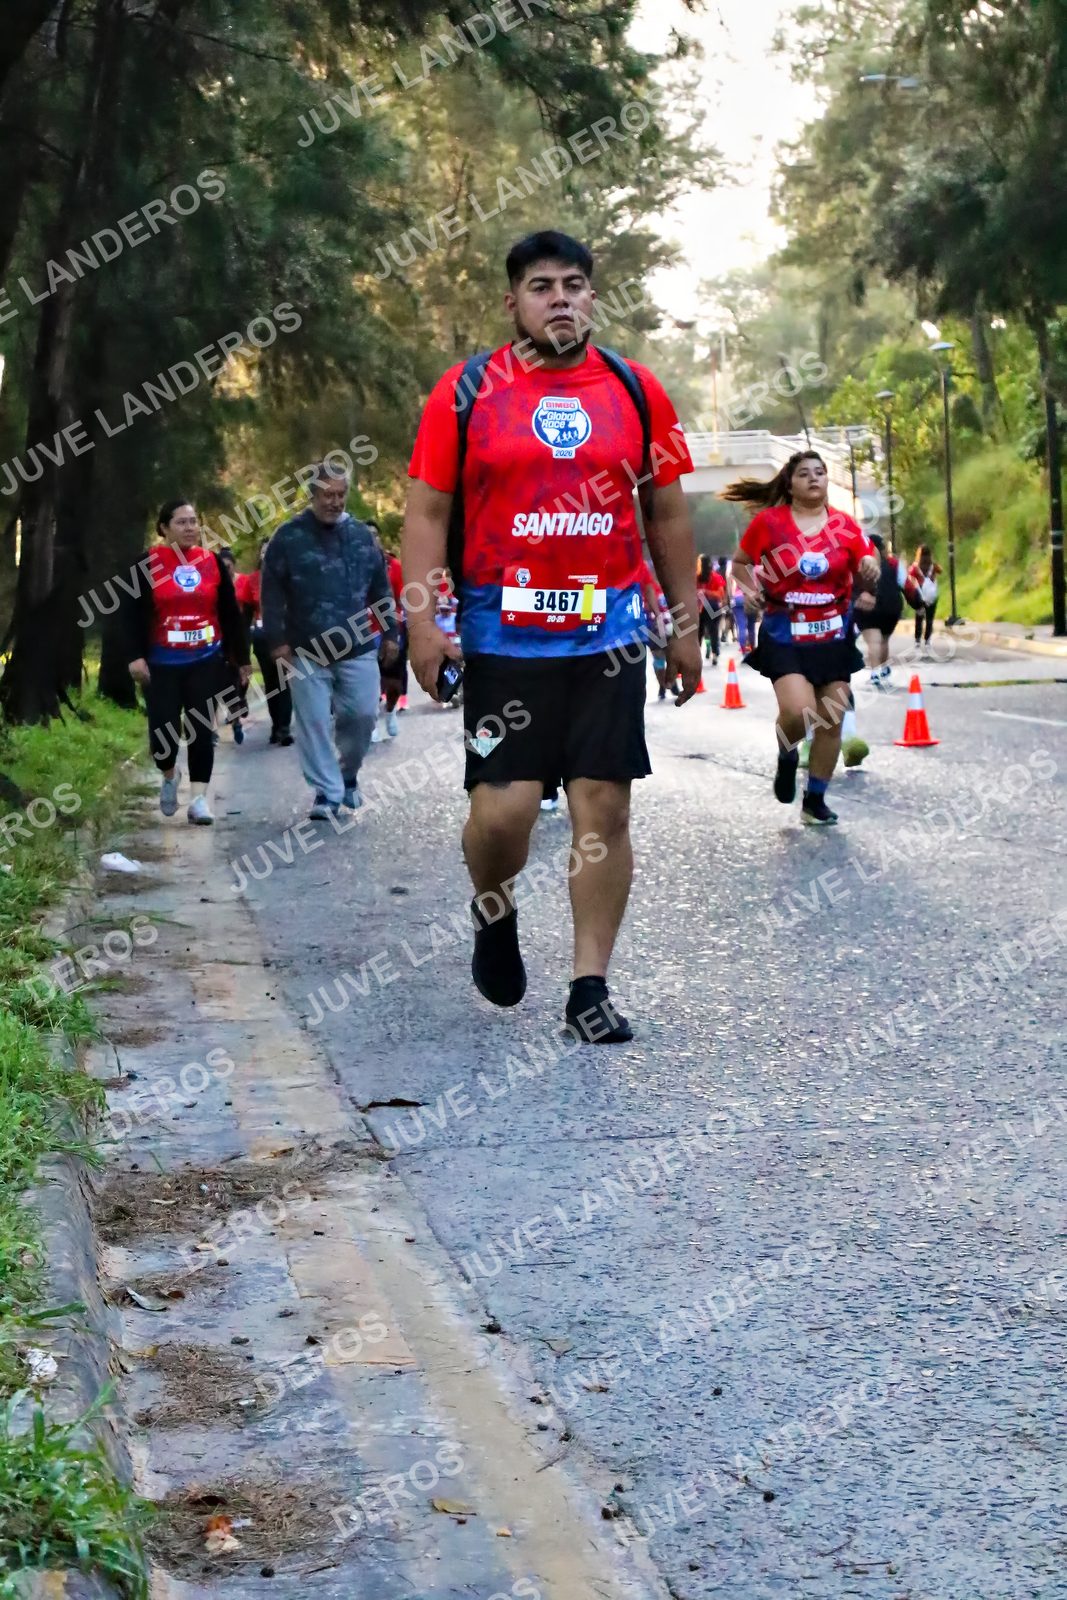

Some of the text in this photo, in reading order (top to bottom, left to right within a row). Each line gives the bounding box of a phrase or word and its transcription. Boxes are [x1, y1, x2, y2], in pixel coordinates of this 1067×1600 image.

[541, 419, 566, 429] Race
[547, 411, 577, 421] Global
[512, 512, 614, 537] SANTIAGO
[534, 590, 580, 612] 3467
